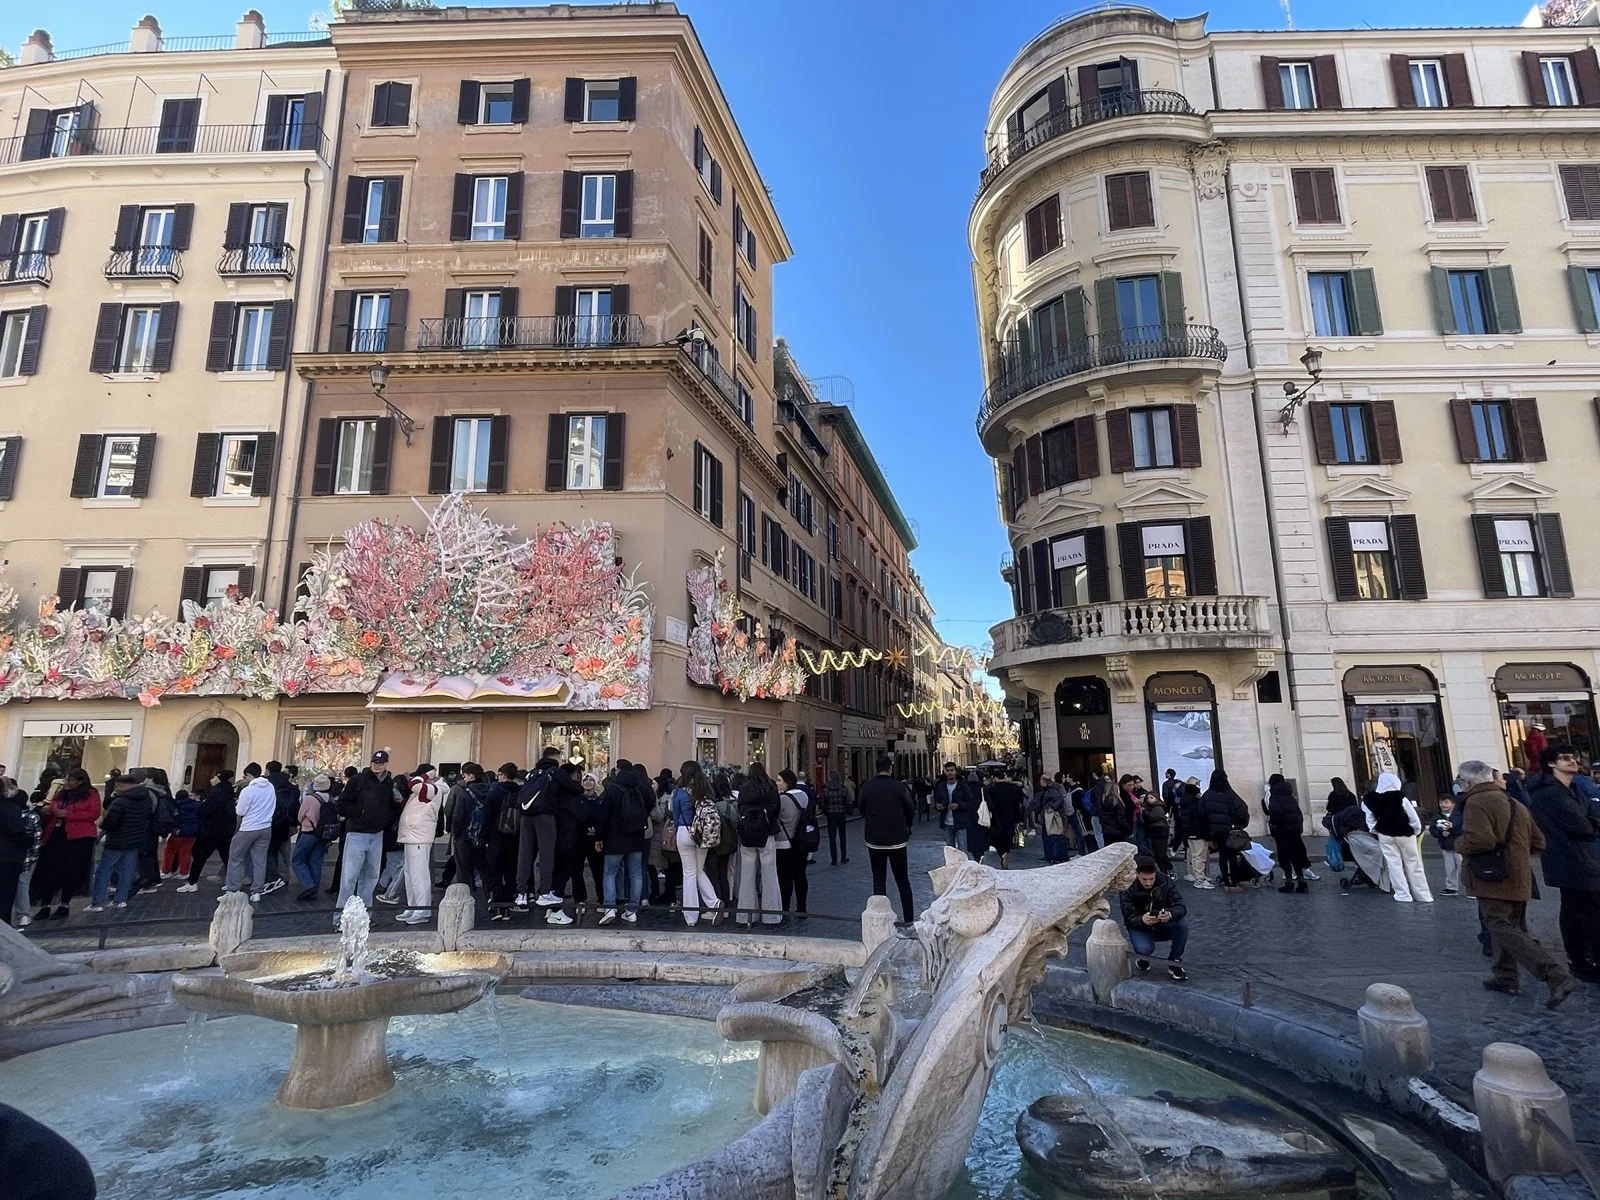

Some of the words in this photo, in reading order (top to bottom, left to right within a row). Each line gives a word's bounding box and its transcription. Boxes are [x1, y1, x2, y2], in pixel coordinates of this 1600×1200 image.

[1203, 170, 1218, 178] 1914
[1148, 542, 1180, 550] PRADA
[1057, 552, 1083, 563] PRADA
[1153, 686, 1205, 696] MONCLER
[58, 723, 94, 734] DIOR
[560, 726, 590, 736] DIOR
[314, 729, 345, 740] DIOR
